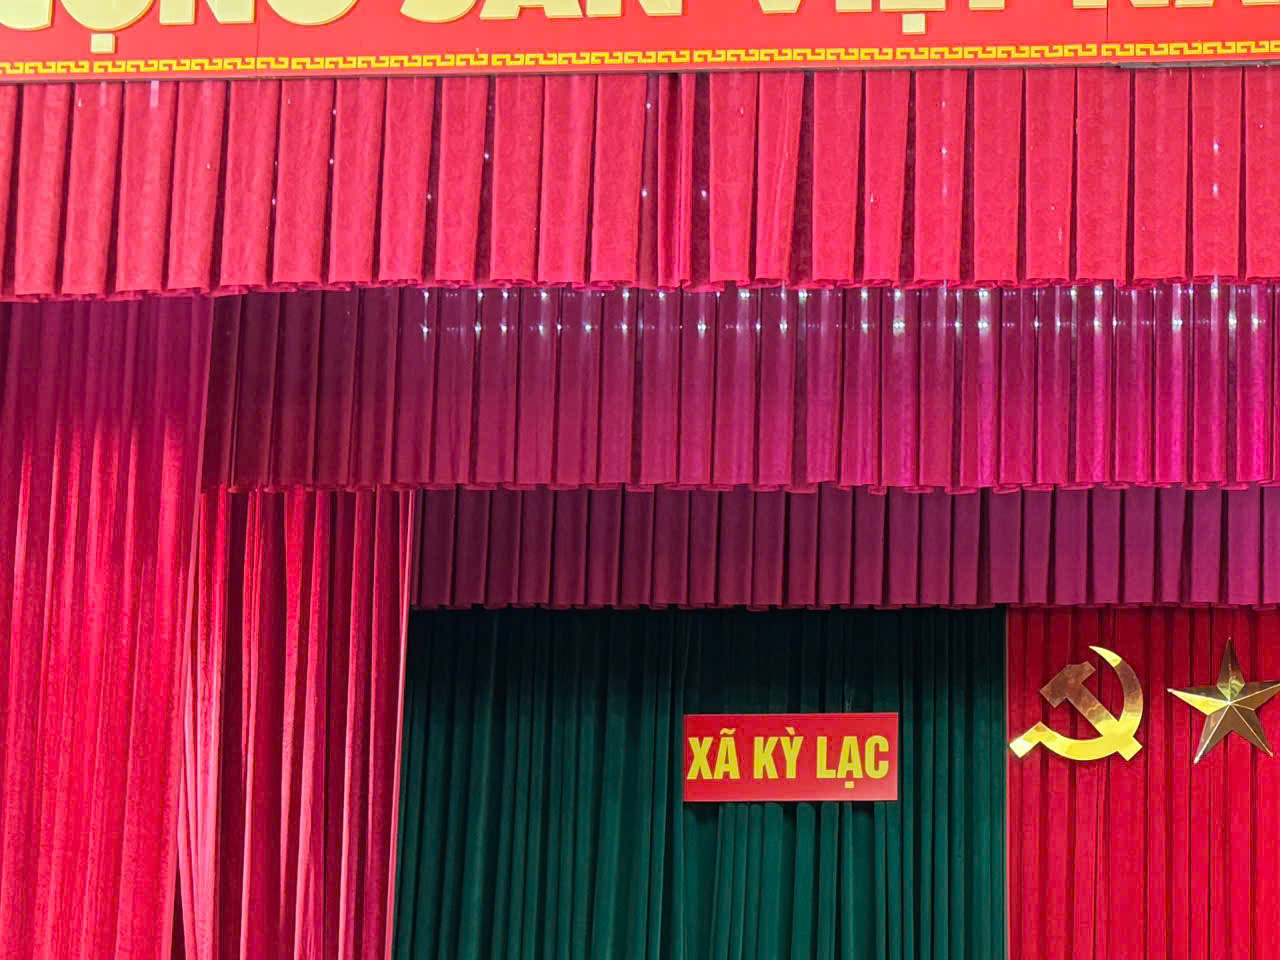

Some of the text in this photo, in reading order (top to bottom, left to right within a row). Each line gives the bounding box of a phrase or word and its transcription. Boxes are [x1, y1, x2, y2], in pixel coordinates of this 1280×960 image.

[687, 727, 889, 788] XÃ KỲ LẠC
